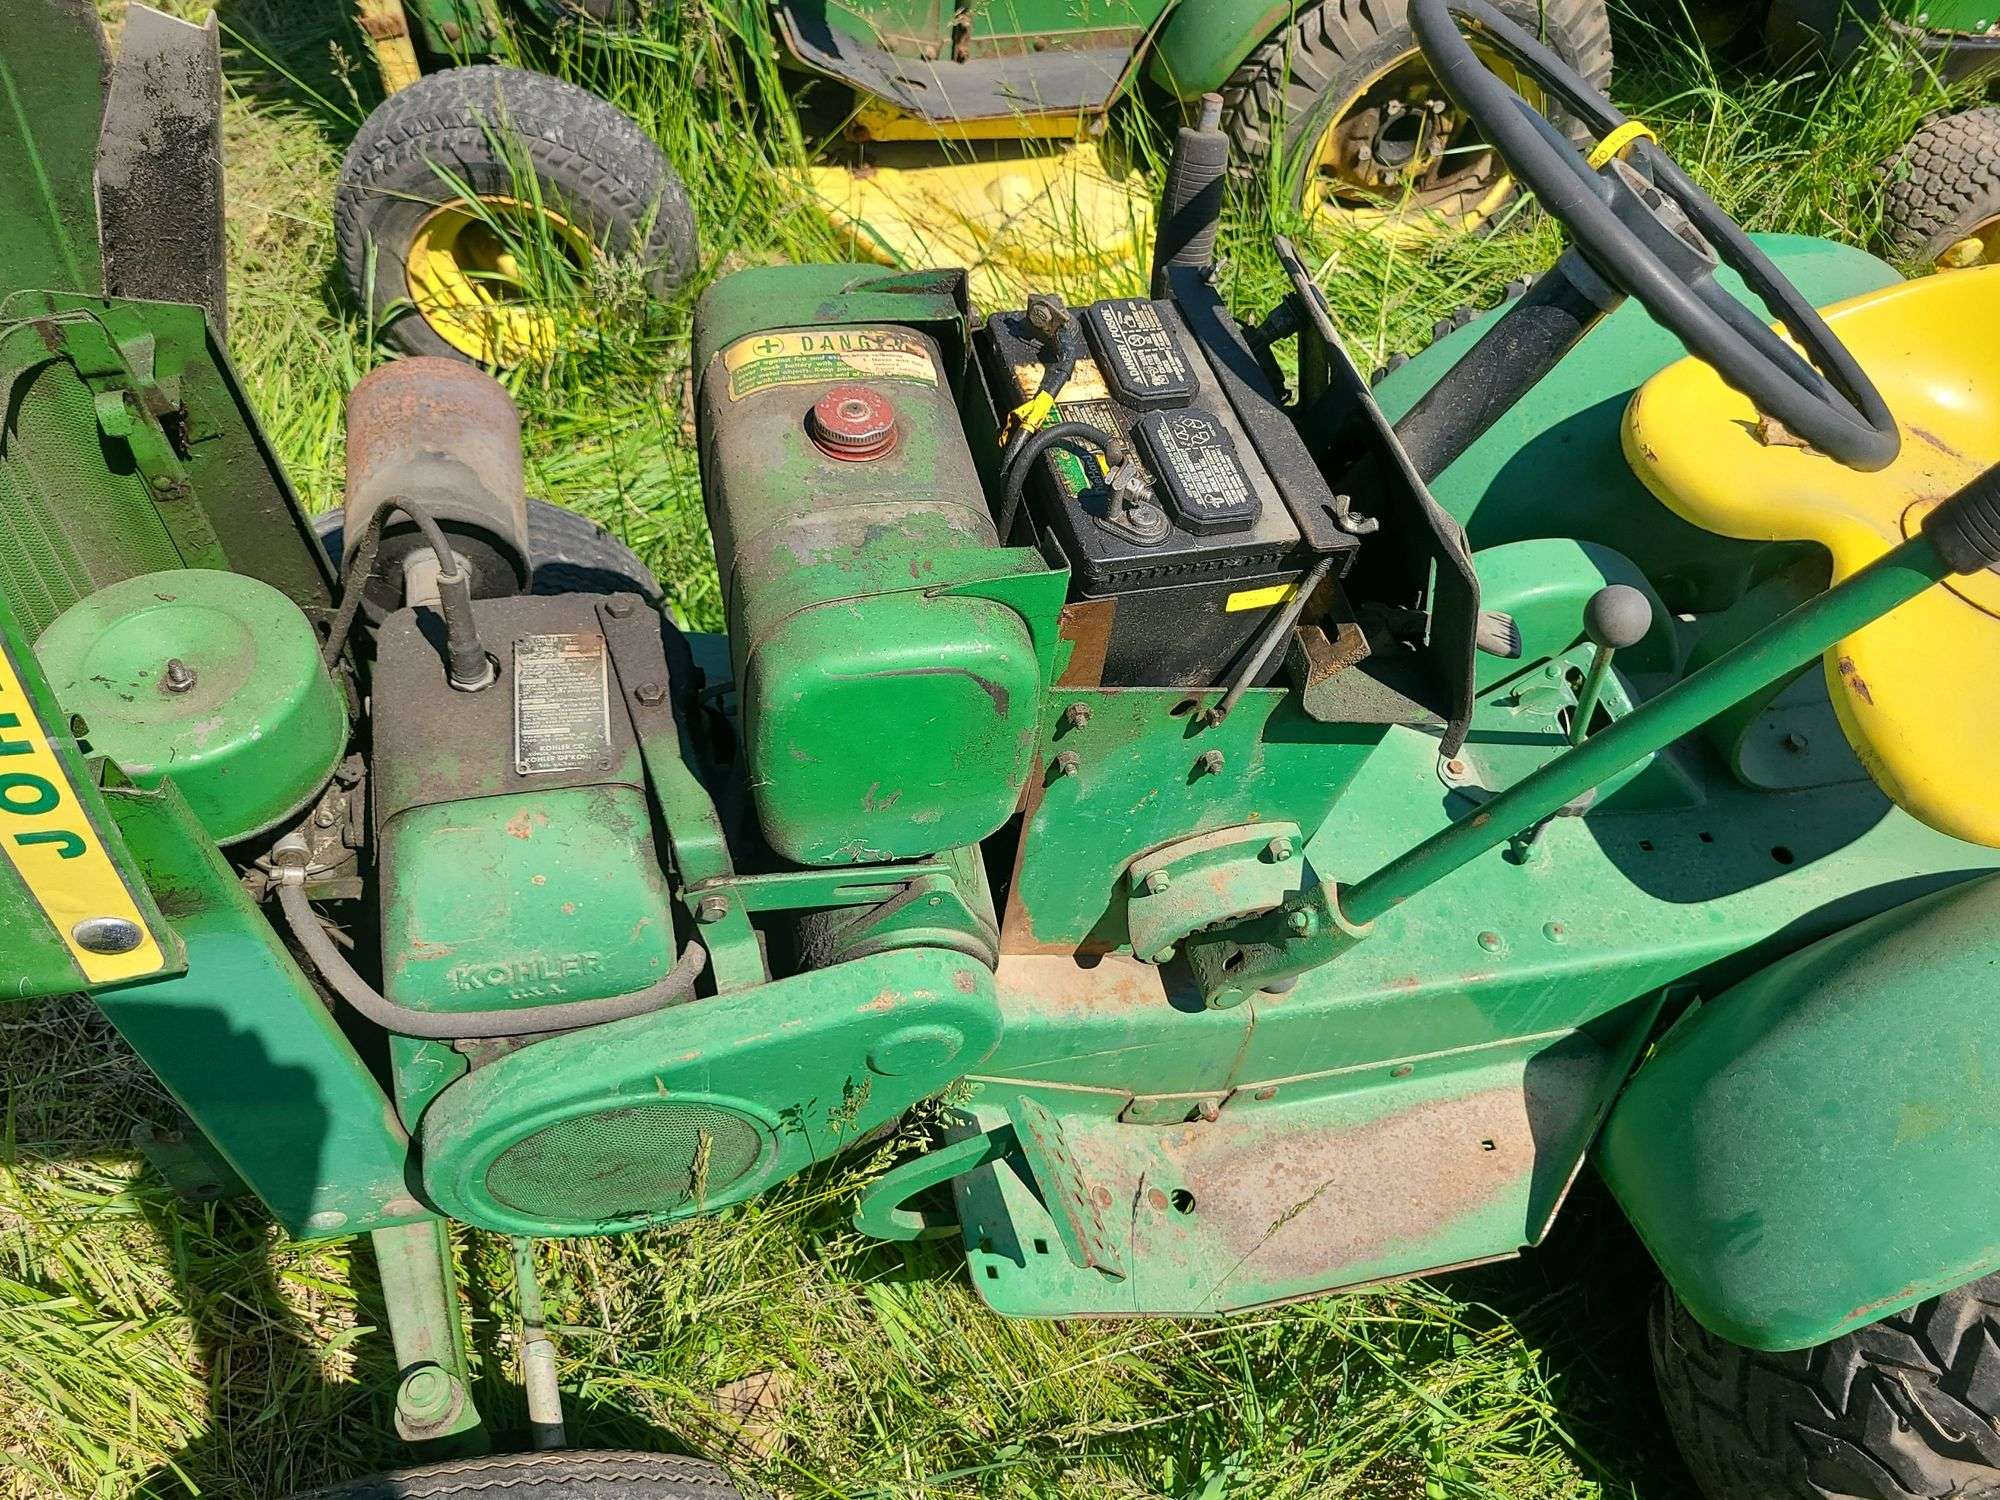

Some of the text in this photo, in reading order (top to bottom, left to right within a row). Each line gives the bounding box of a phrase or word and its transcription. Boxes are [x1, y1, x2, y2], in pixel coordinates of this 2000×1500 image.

[1100, 307, 1120, 338] POISON
[1116, 343, 1140, 378] DANGER
[446, 950, 603, 992] KOHLER
